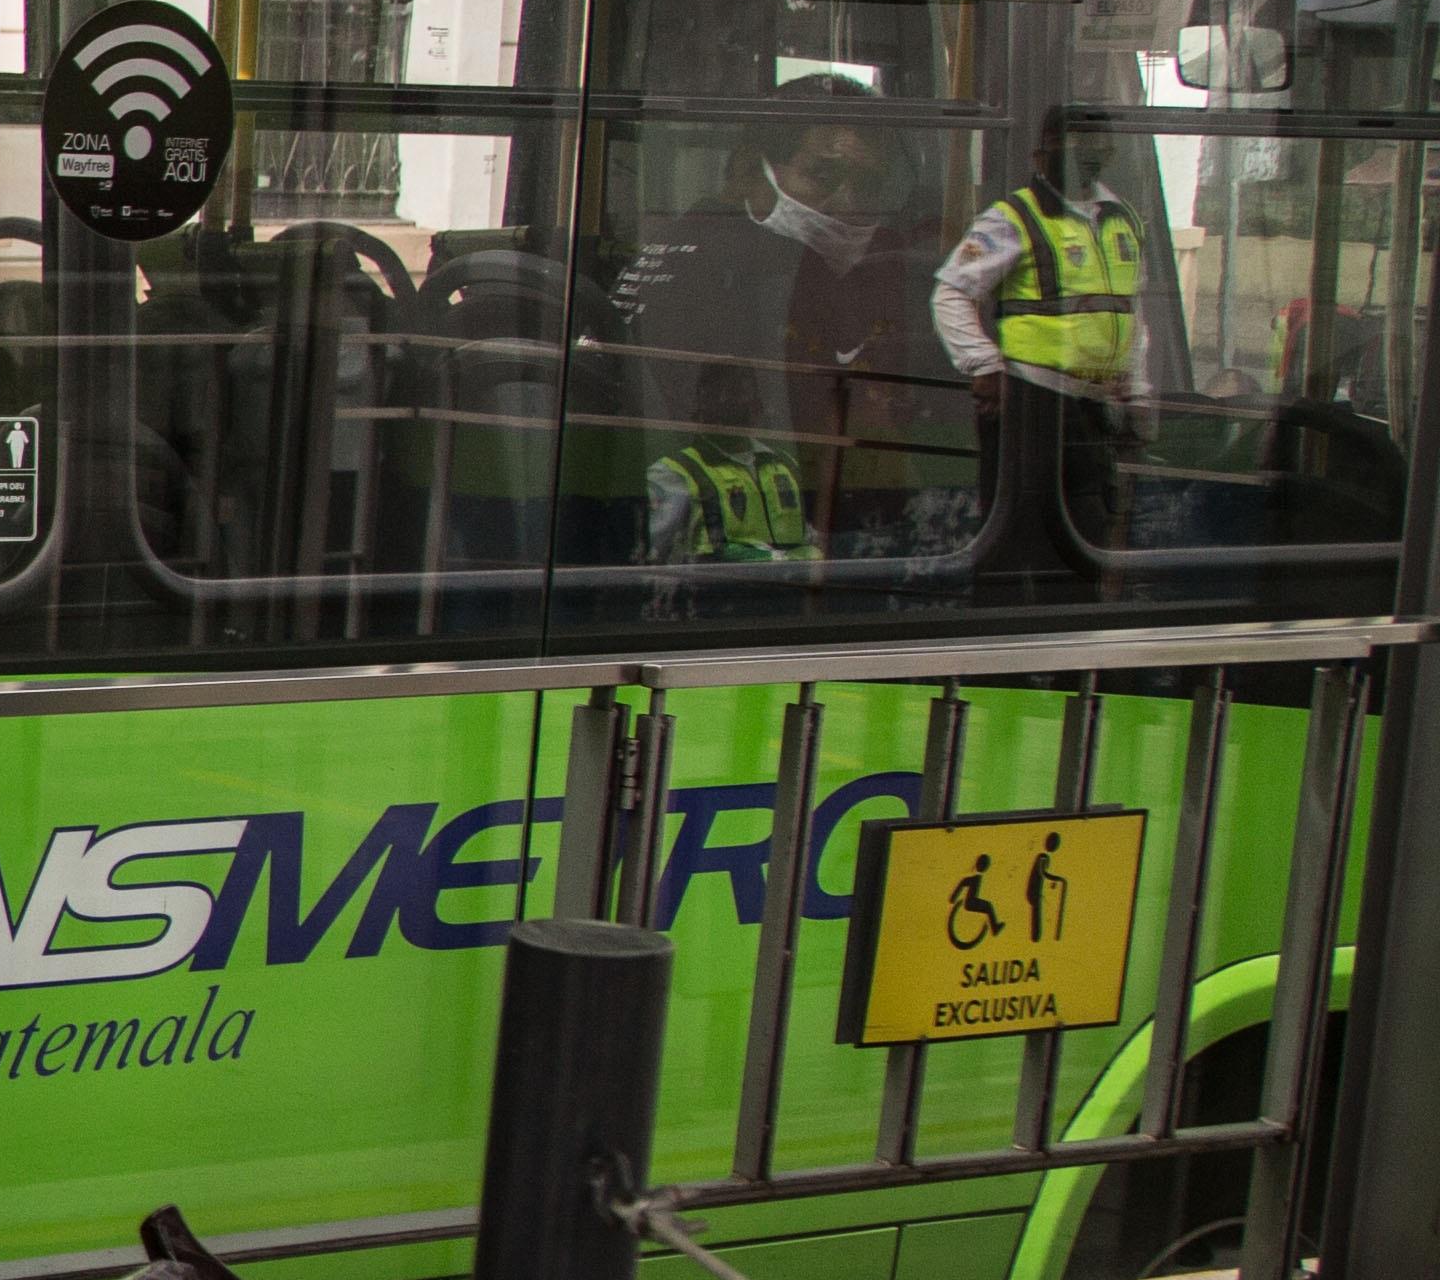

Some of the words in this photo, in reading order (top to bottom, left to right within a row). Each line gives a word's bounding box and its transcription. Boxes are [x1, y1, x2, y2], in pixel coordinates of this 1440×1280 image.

[62, 133, 111, 151] ZONA
[164, 137, 209, 149] INTERNET
[62, 157, 111, 175] Wayfree
[961, 958, 1041, 988] SALIDA
[933, 993, 1058, 1027] EXCLUSIVA
